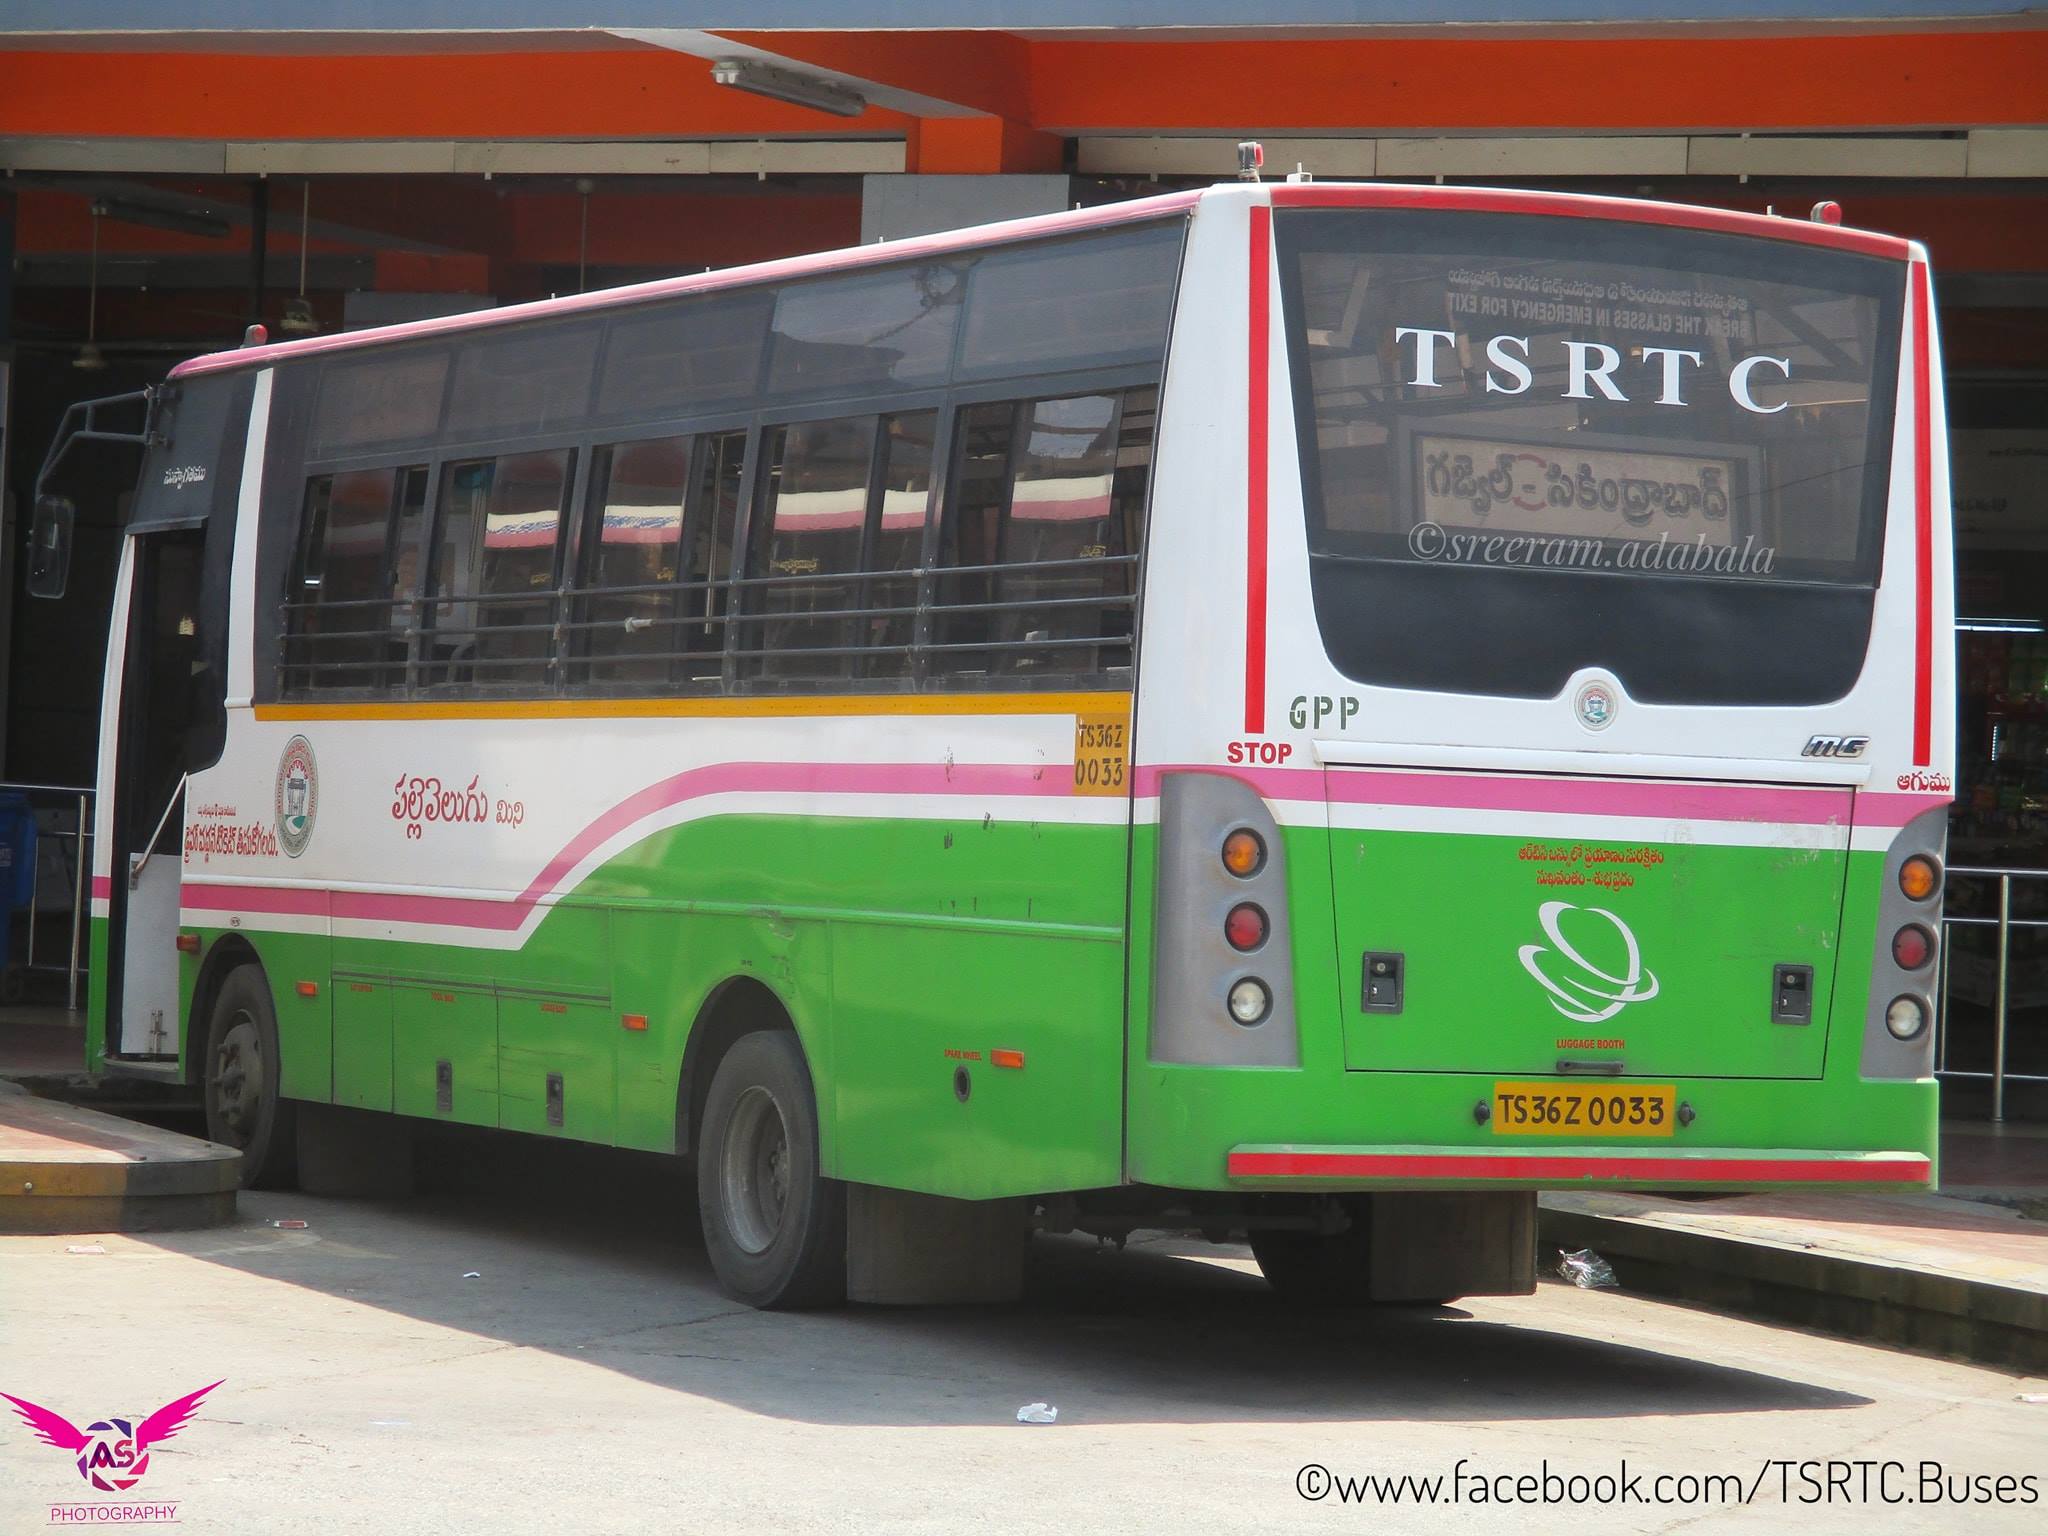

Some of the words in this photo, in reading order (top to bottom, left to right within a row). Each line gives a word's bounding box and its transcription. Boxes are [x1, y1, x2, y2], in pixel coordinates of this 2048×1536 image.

[1289, 695, 1360, 730] GPP
[1078, 724, 1123, 748] TS36Z
[1227, 741, 1292, 764] STOP
[1075, 757, 1123, 786] 0033
[1896, 771, 1951, 792] ఆగుము
[391, 773, 488, 839] పల్లెవెలుగు
[495, 799, 524, 829] మిని
[1556, 1039, 1595, 1049] LUGGAGE
[1597, 1039, 1625, 1049] BOOTH
